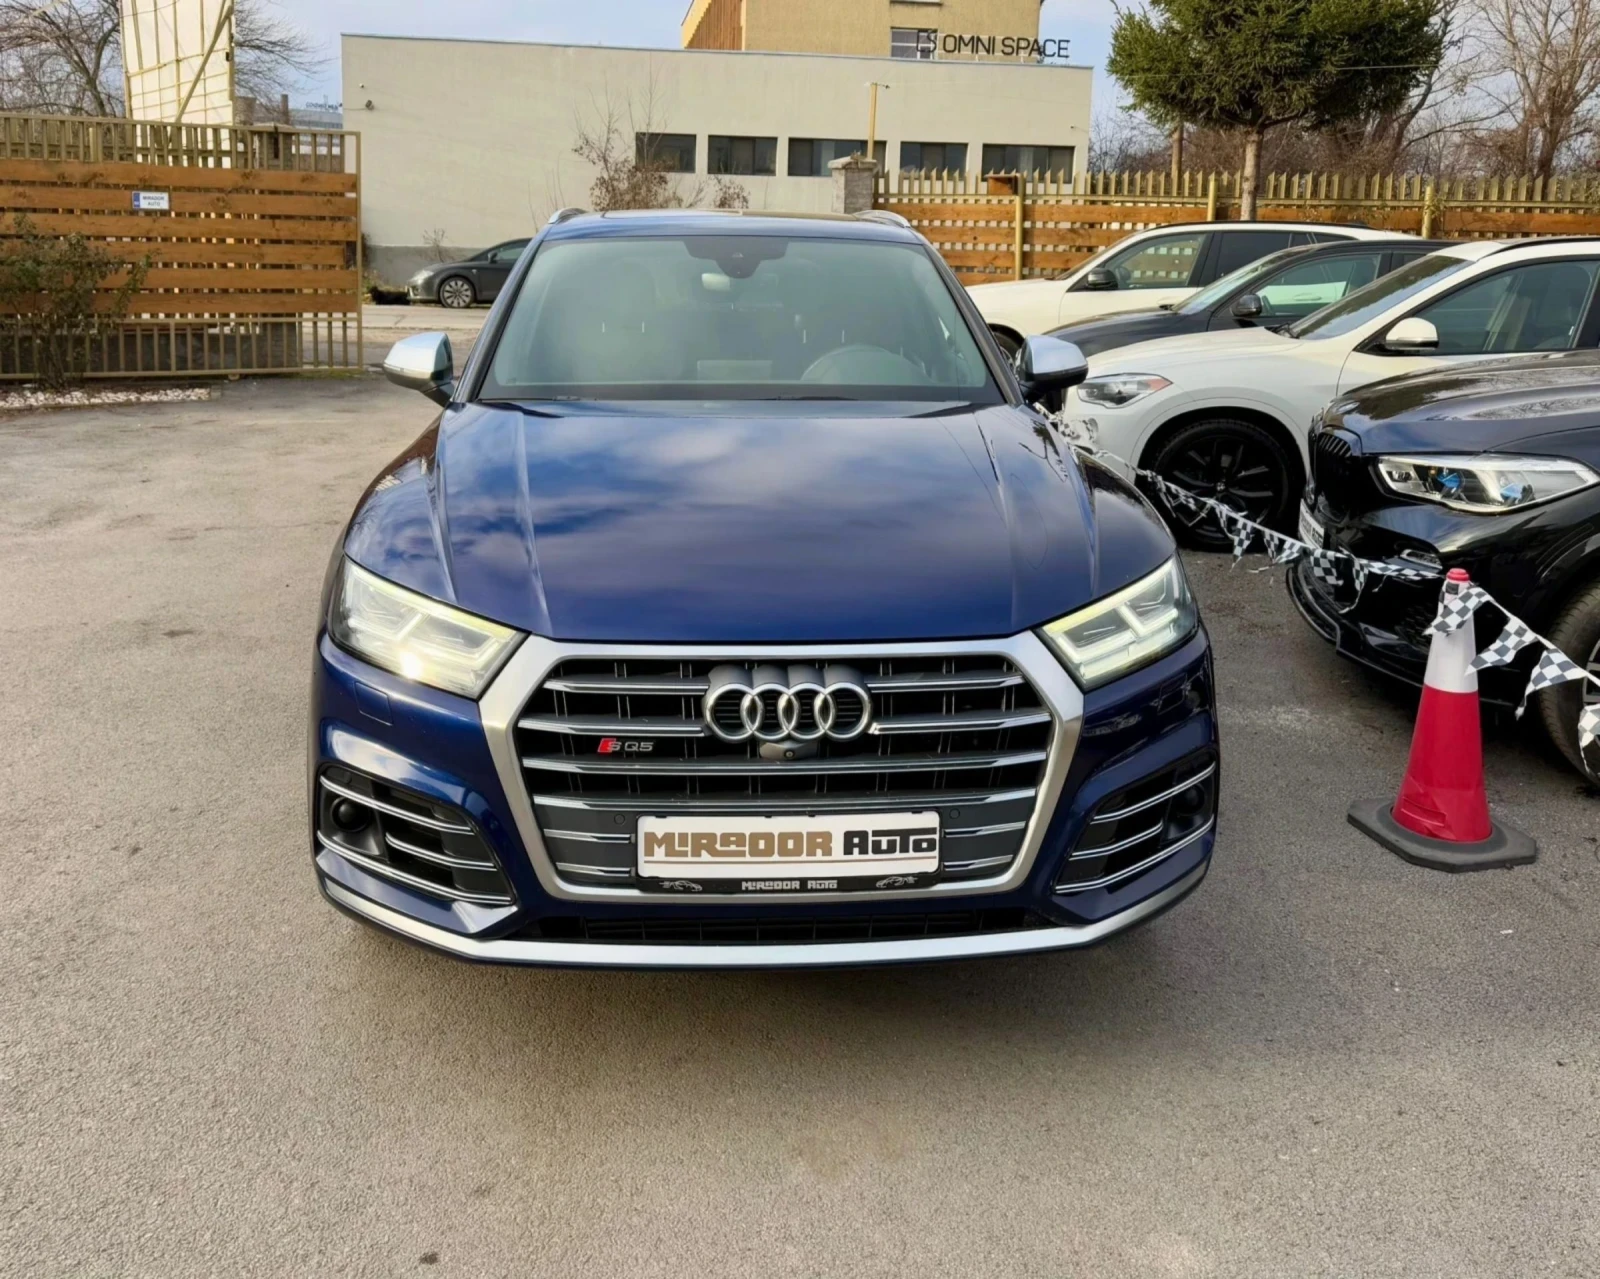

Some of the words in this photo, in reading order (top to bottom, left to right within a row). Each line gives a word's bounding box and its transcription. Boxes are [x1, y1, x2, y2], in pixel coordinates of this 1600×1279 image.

[943, 34, 995, 55] OMNI
[1001, 37, 1071, 58] SPACE
[605, 740, 654, 752] SQ5
